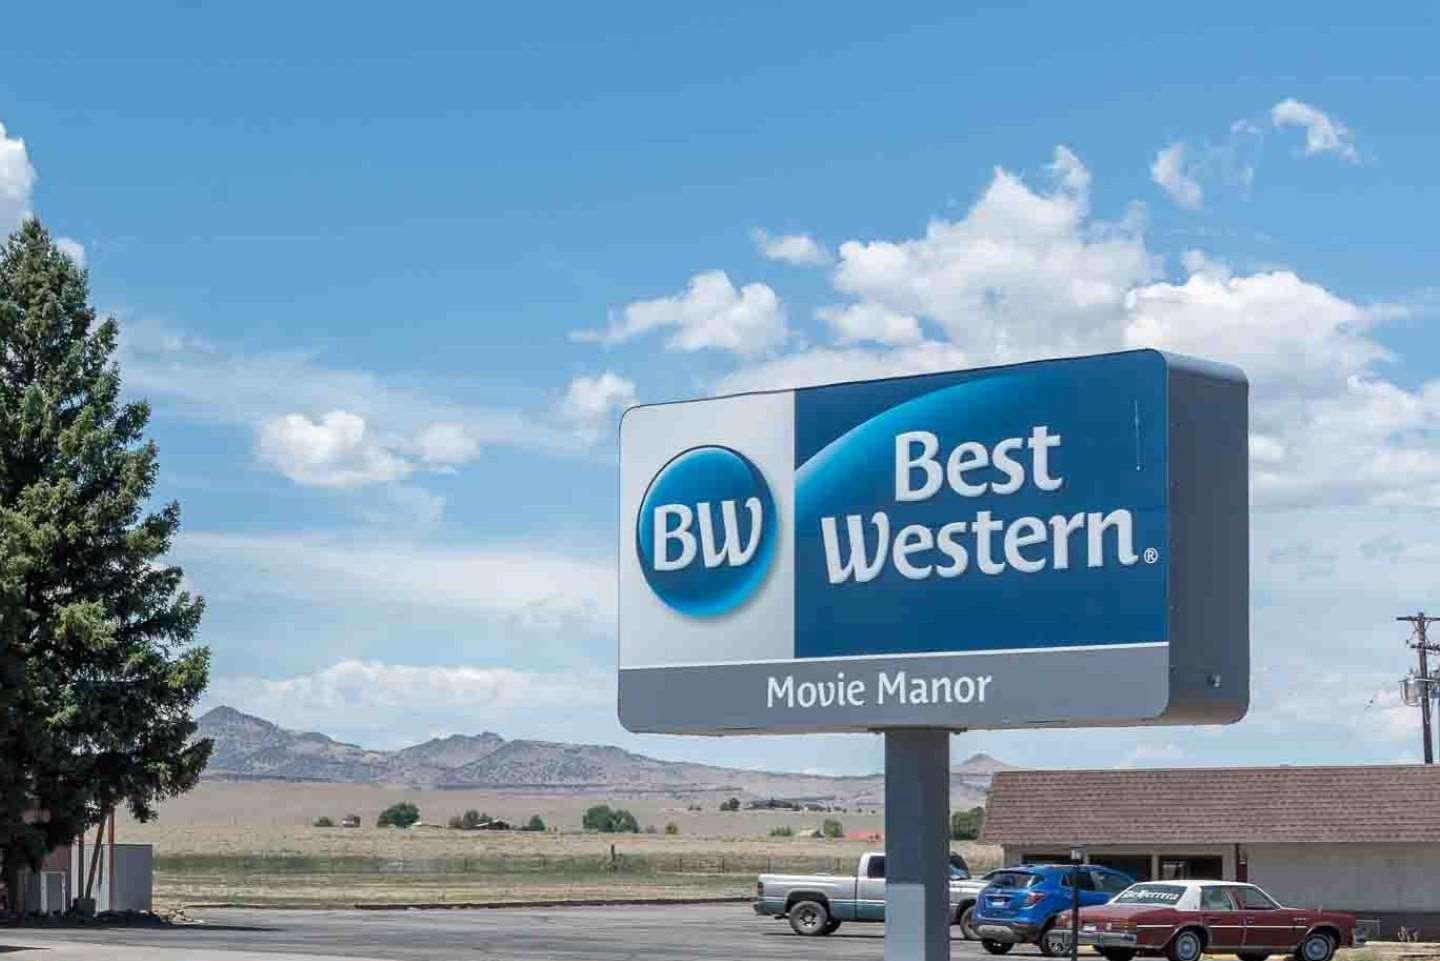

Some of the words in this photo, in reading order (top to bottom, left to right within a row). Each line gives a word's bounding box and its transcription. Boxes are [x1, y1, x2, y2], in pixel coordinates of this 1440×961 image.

[894, 425, 1064, 503] Best
[652, 497, 764, 573] BW
[766, 672, 867, 709] Movie
[877, 670, 994, 706] Manor
